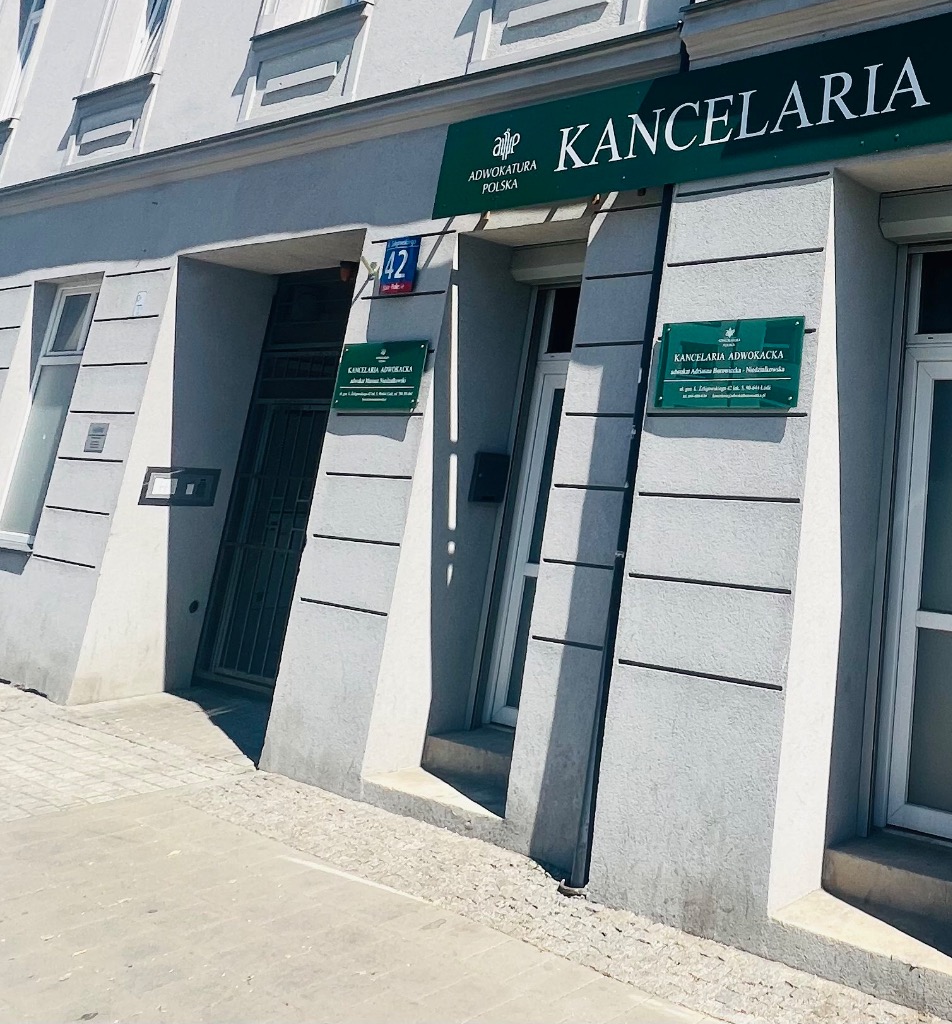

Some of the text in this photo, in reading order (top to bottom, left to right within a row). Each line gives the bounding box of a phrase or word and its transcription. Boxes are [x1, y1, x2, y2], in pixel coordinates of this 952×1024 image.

[554, 57, 930, 172] KANCELARIA
[468, 159, 537, 182] ADWOKATURA
[482, 179, 518, 194] POLSKA
[384, 249, 408, 280] 42
[674, 350, 784, 362] KANCELARIA ADWOKACKA
